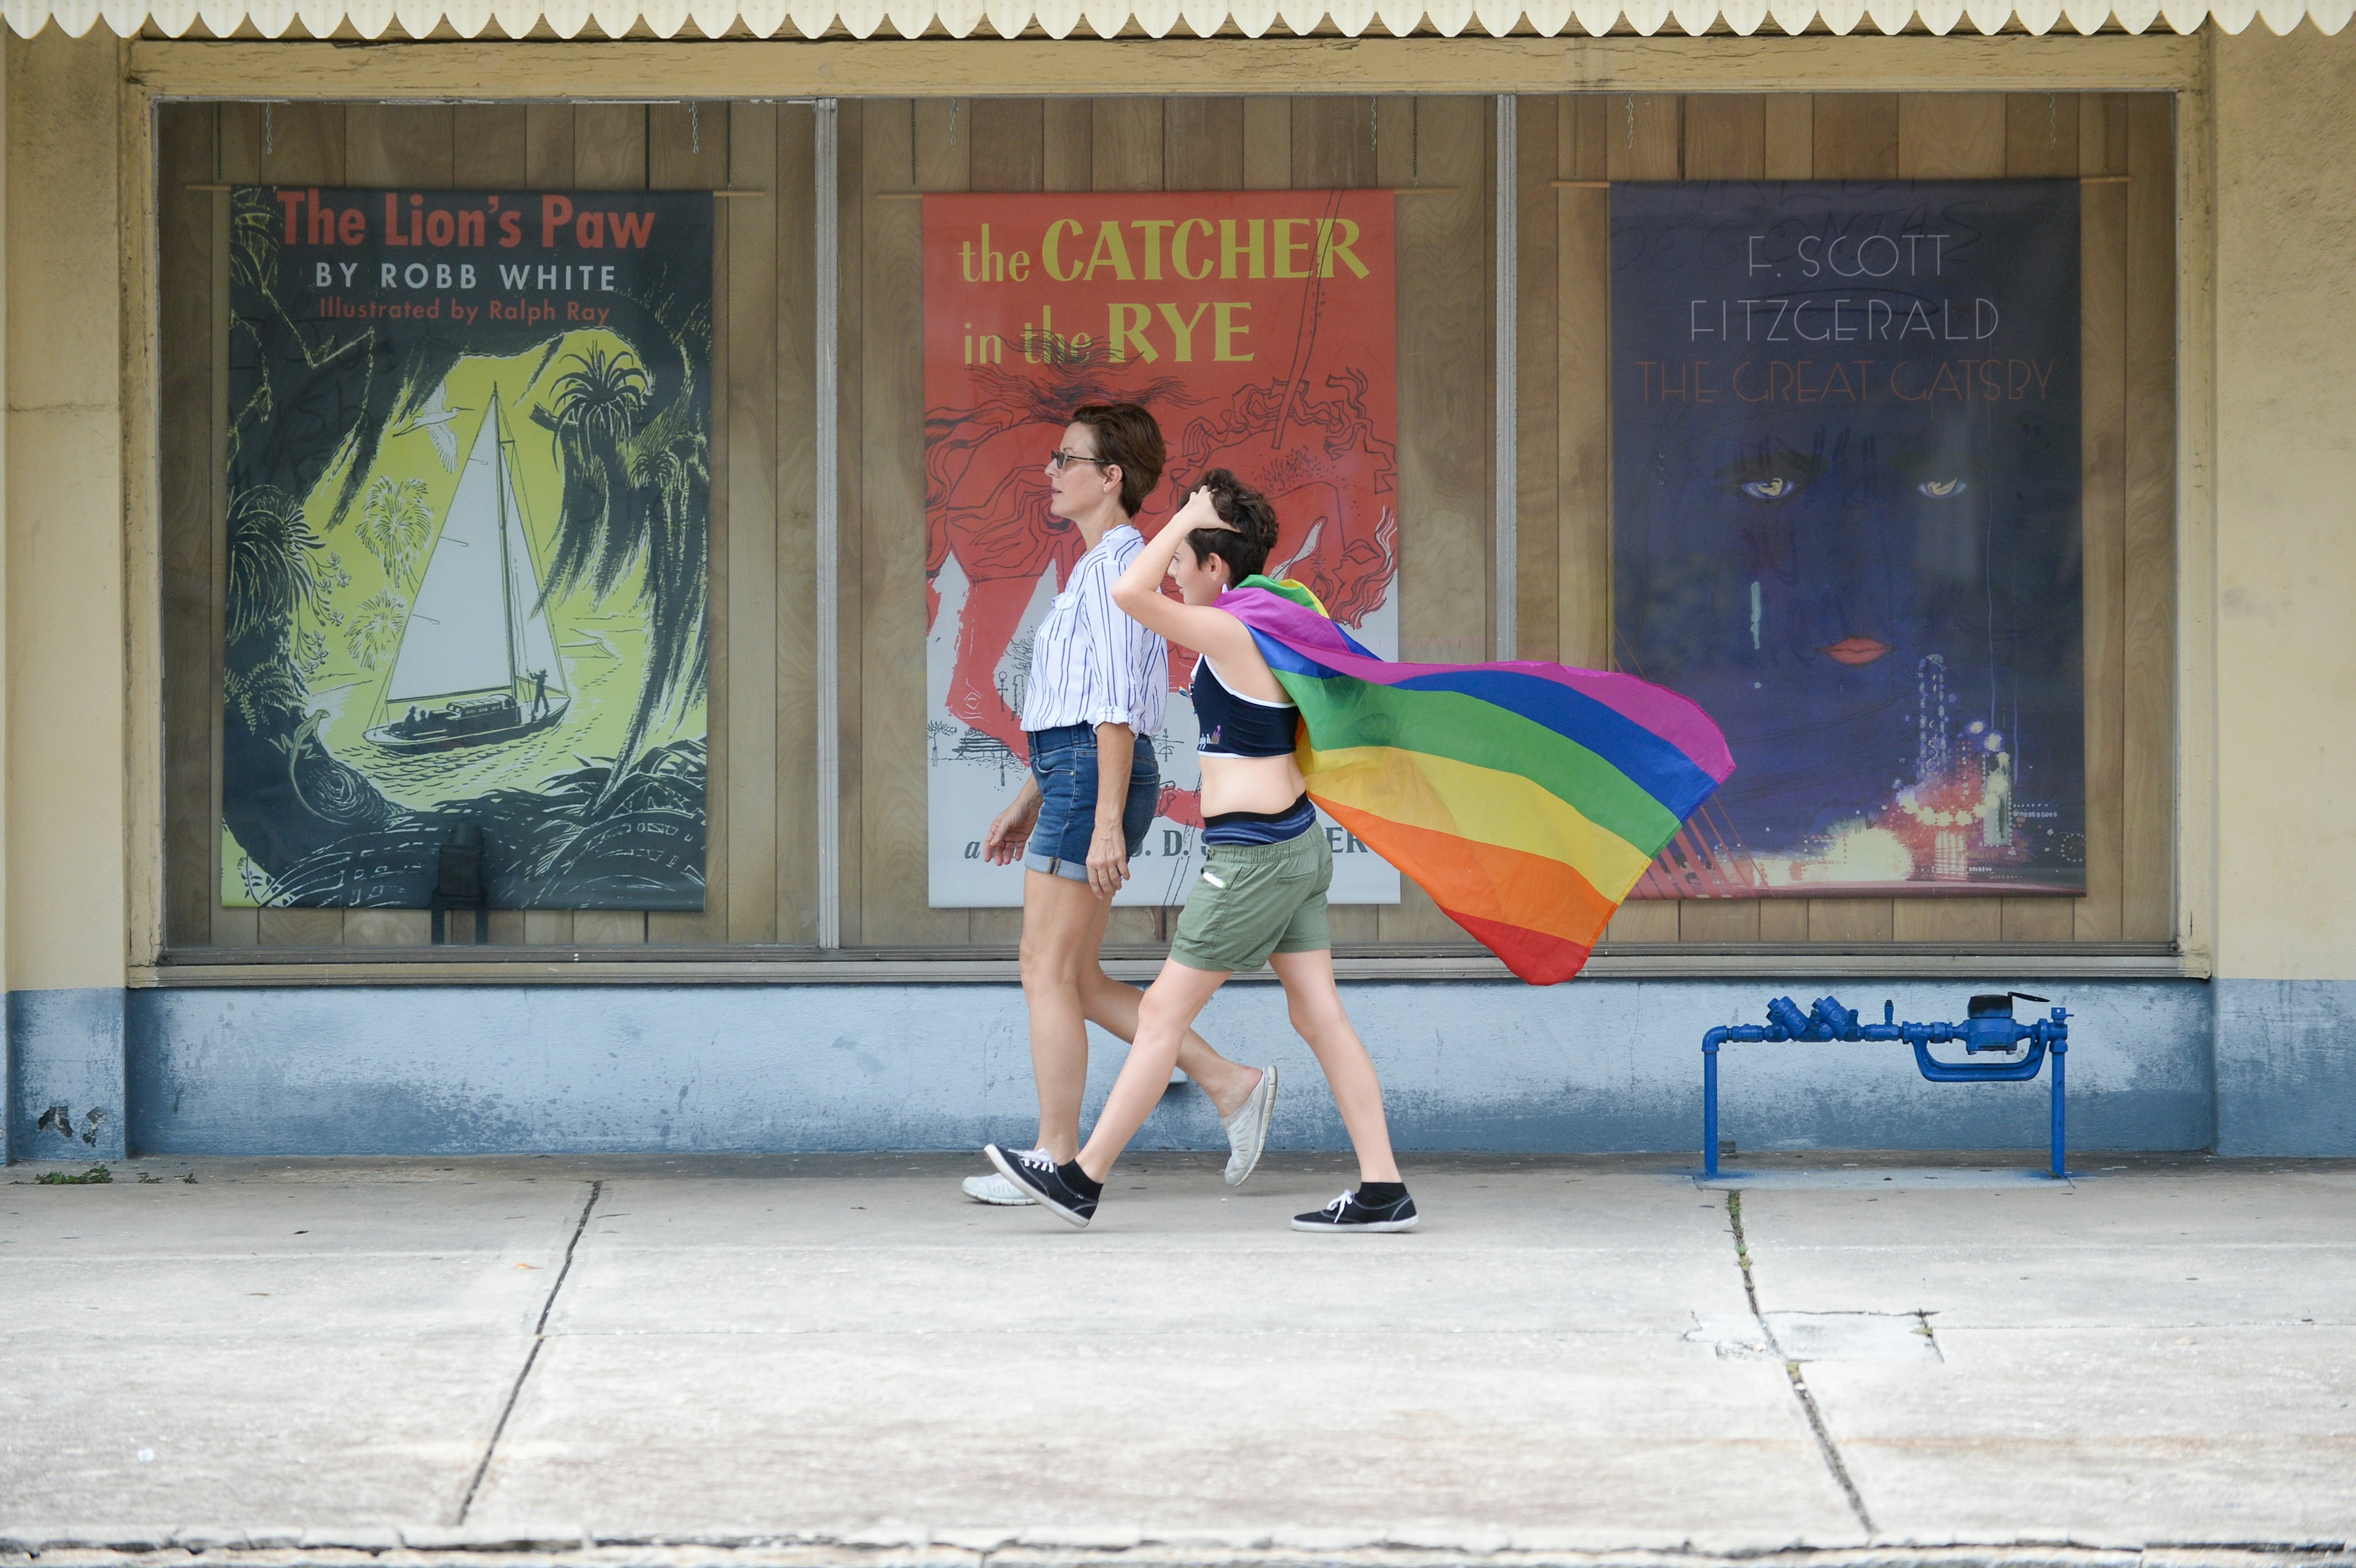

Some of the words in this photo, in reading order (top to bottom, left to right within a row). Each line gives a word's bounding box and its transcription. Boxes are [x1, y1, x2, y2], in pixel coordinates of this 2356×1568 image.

[276, 188, 366, 245] The
[387, 193, 521, 247] Lion's
[543, 194, 655, 248] Paw
[958, 222, 1030, 283] the
[1041, 217, 1370, 282] CATCHER
[1749, 235, 1782, 277] F.
[1798, 234, 1950, 277] SCOTT
[316, 262, 357, 288] BY
[381, 263, 477, 290] ROBB
[498, 264, 614, 291] WHITE
[320, 296, 440, 320] Illustrated
[452, 299, 479, 325] by
[490, 299, 555, 326] Ralph
[567, 301, 610, 326] Ray
[964, 323, 1001, 364] in
[1019, 304, 1091, 364] the
[1107, 301, 1255, 364] RYE
[1691, 298, 1999, 341] FITZGERALD
[1636, 361, 1716, 402] THE
[1732, 359, 1876, 402] GREAT
[1890, 358, 2055, 401] GATSBY
[964, 841, 981, 859] a
[1161, 829, 1189, 857] D.
